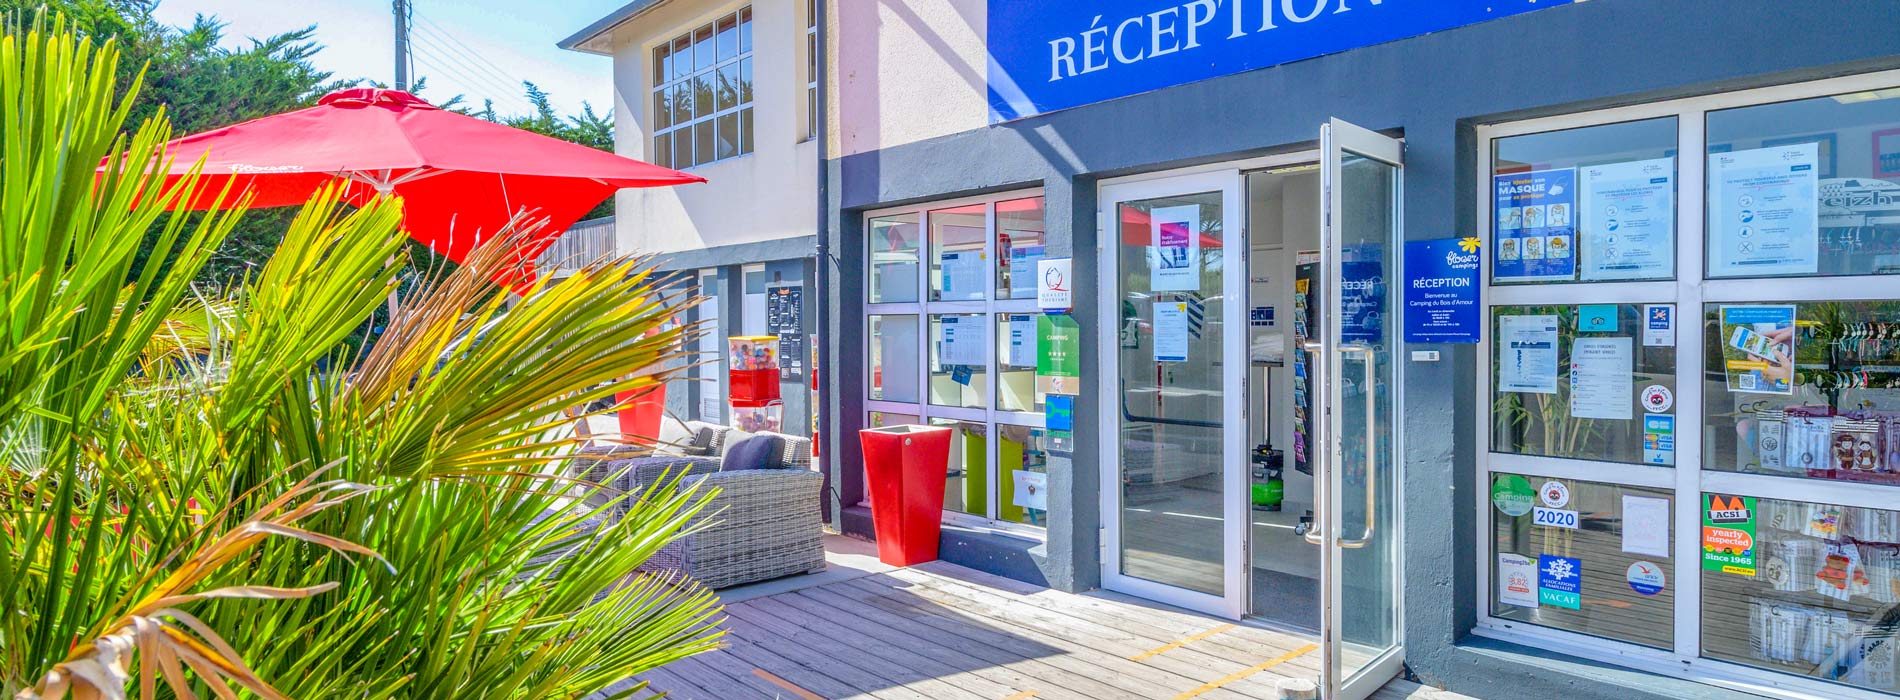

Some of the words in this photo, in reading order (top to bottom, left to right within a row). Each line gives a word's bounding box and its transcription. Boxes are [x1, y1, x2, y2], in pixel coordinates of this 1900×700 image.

[1499, 184, 1546, 195] MASQUE
[1413, 277, 1470, 288] RÉCEPTION
[1537, 510, 1575, 526] 2020
[1712, 529, 1743, 540] yearly
[1706, 535, 1749, 547] inspected
[1705, 552, 1729, 562] Since
[1730, 556, 1752, 565] 1965
[1543, 592, 1576, 604] VACAF
